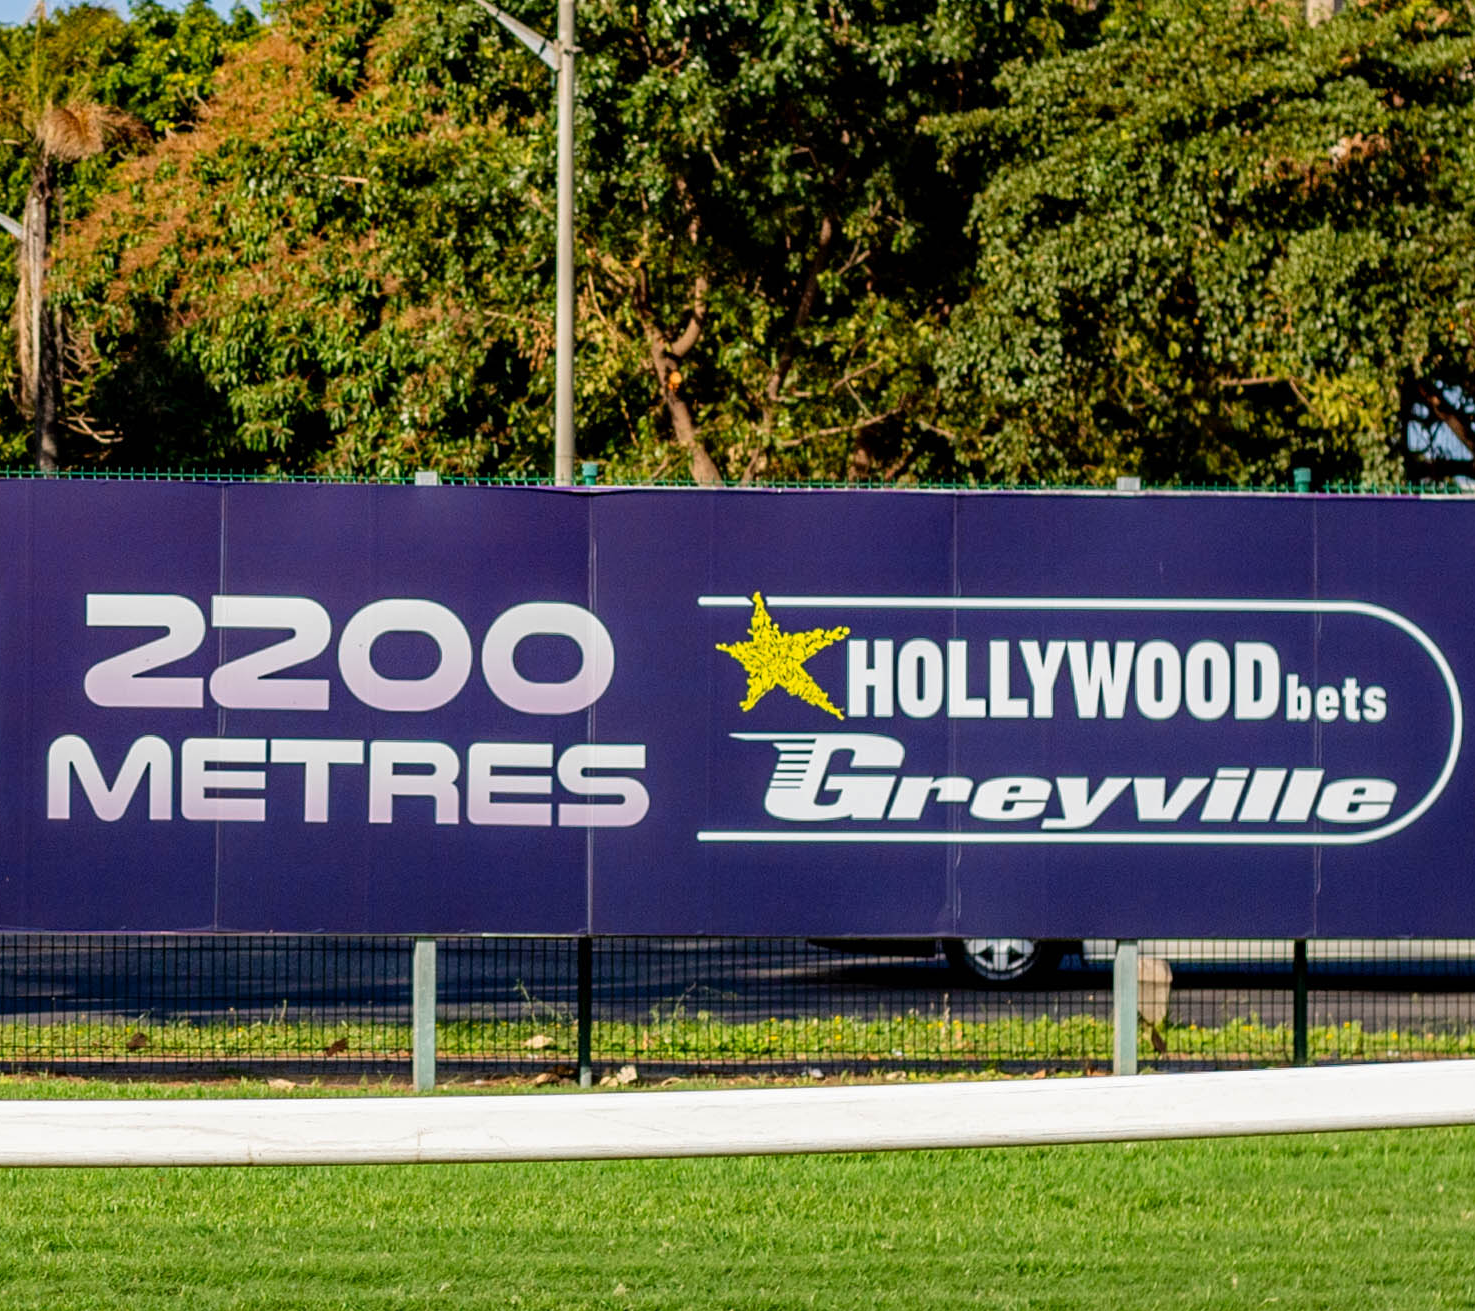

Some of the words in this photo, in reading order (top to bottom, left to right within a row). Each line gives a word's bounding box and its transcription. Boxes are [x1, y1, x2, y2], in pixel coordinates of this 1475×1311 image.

[84, 593, 615, 715] 2200
[47, 734, 650, 827] METRES
[730, 732, 1398, 830] Greyville
